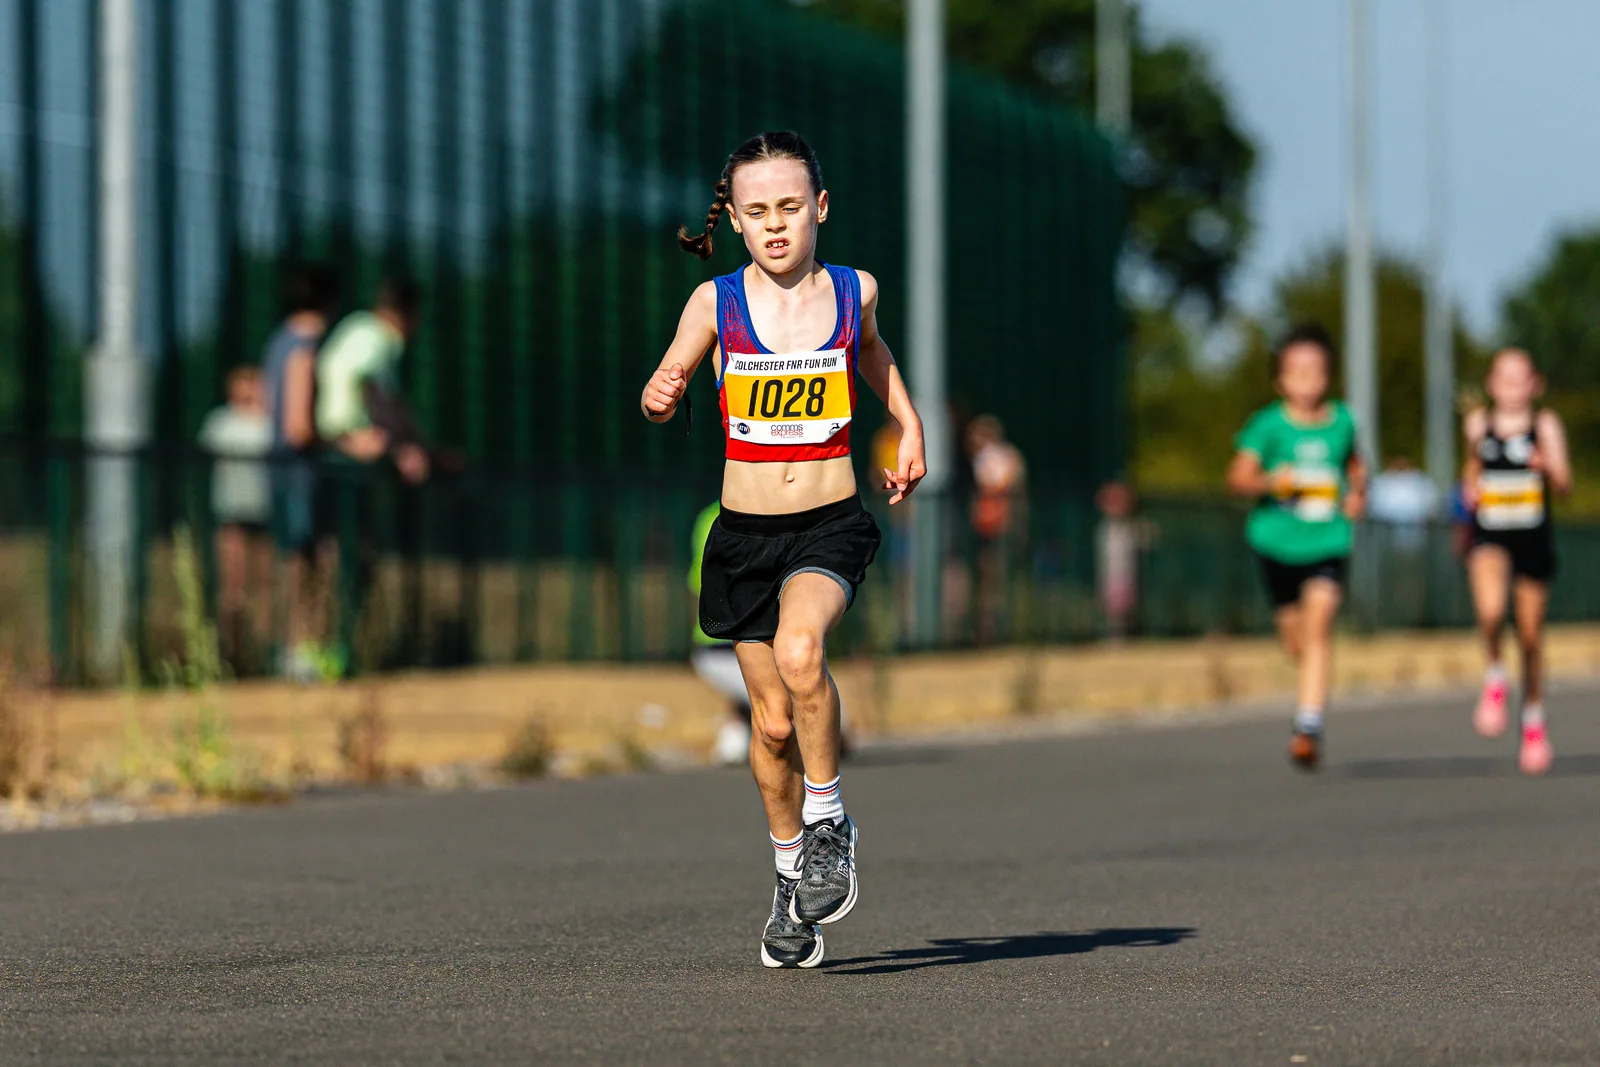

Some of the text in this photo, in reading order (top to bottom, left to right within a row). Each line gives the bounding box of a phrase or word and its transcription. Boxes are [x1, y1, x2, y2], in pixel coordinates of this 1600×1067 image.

[786, 360, 802, 370] FNR
[804, 359, 820, 369] FUN
[822, 357, 837, 368] RUN
[748, 377, 827, 418] 1028
[771, 430, 804, 438] express
